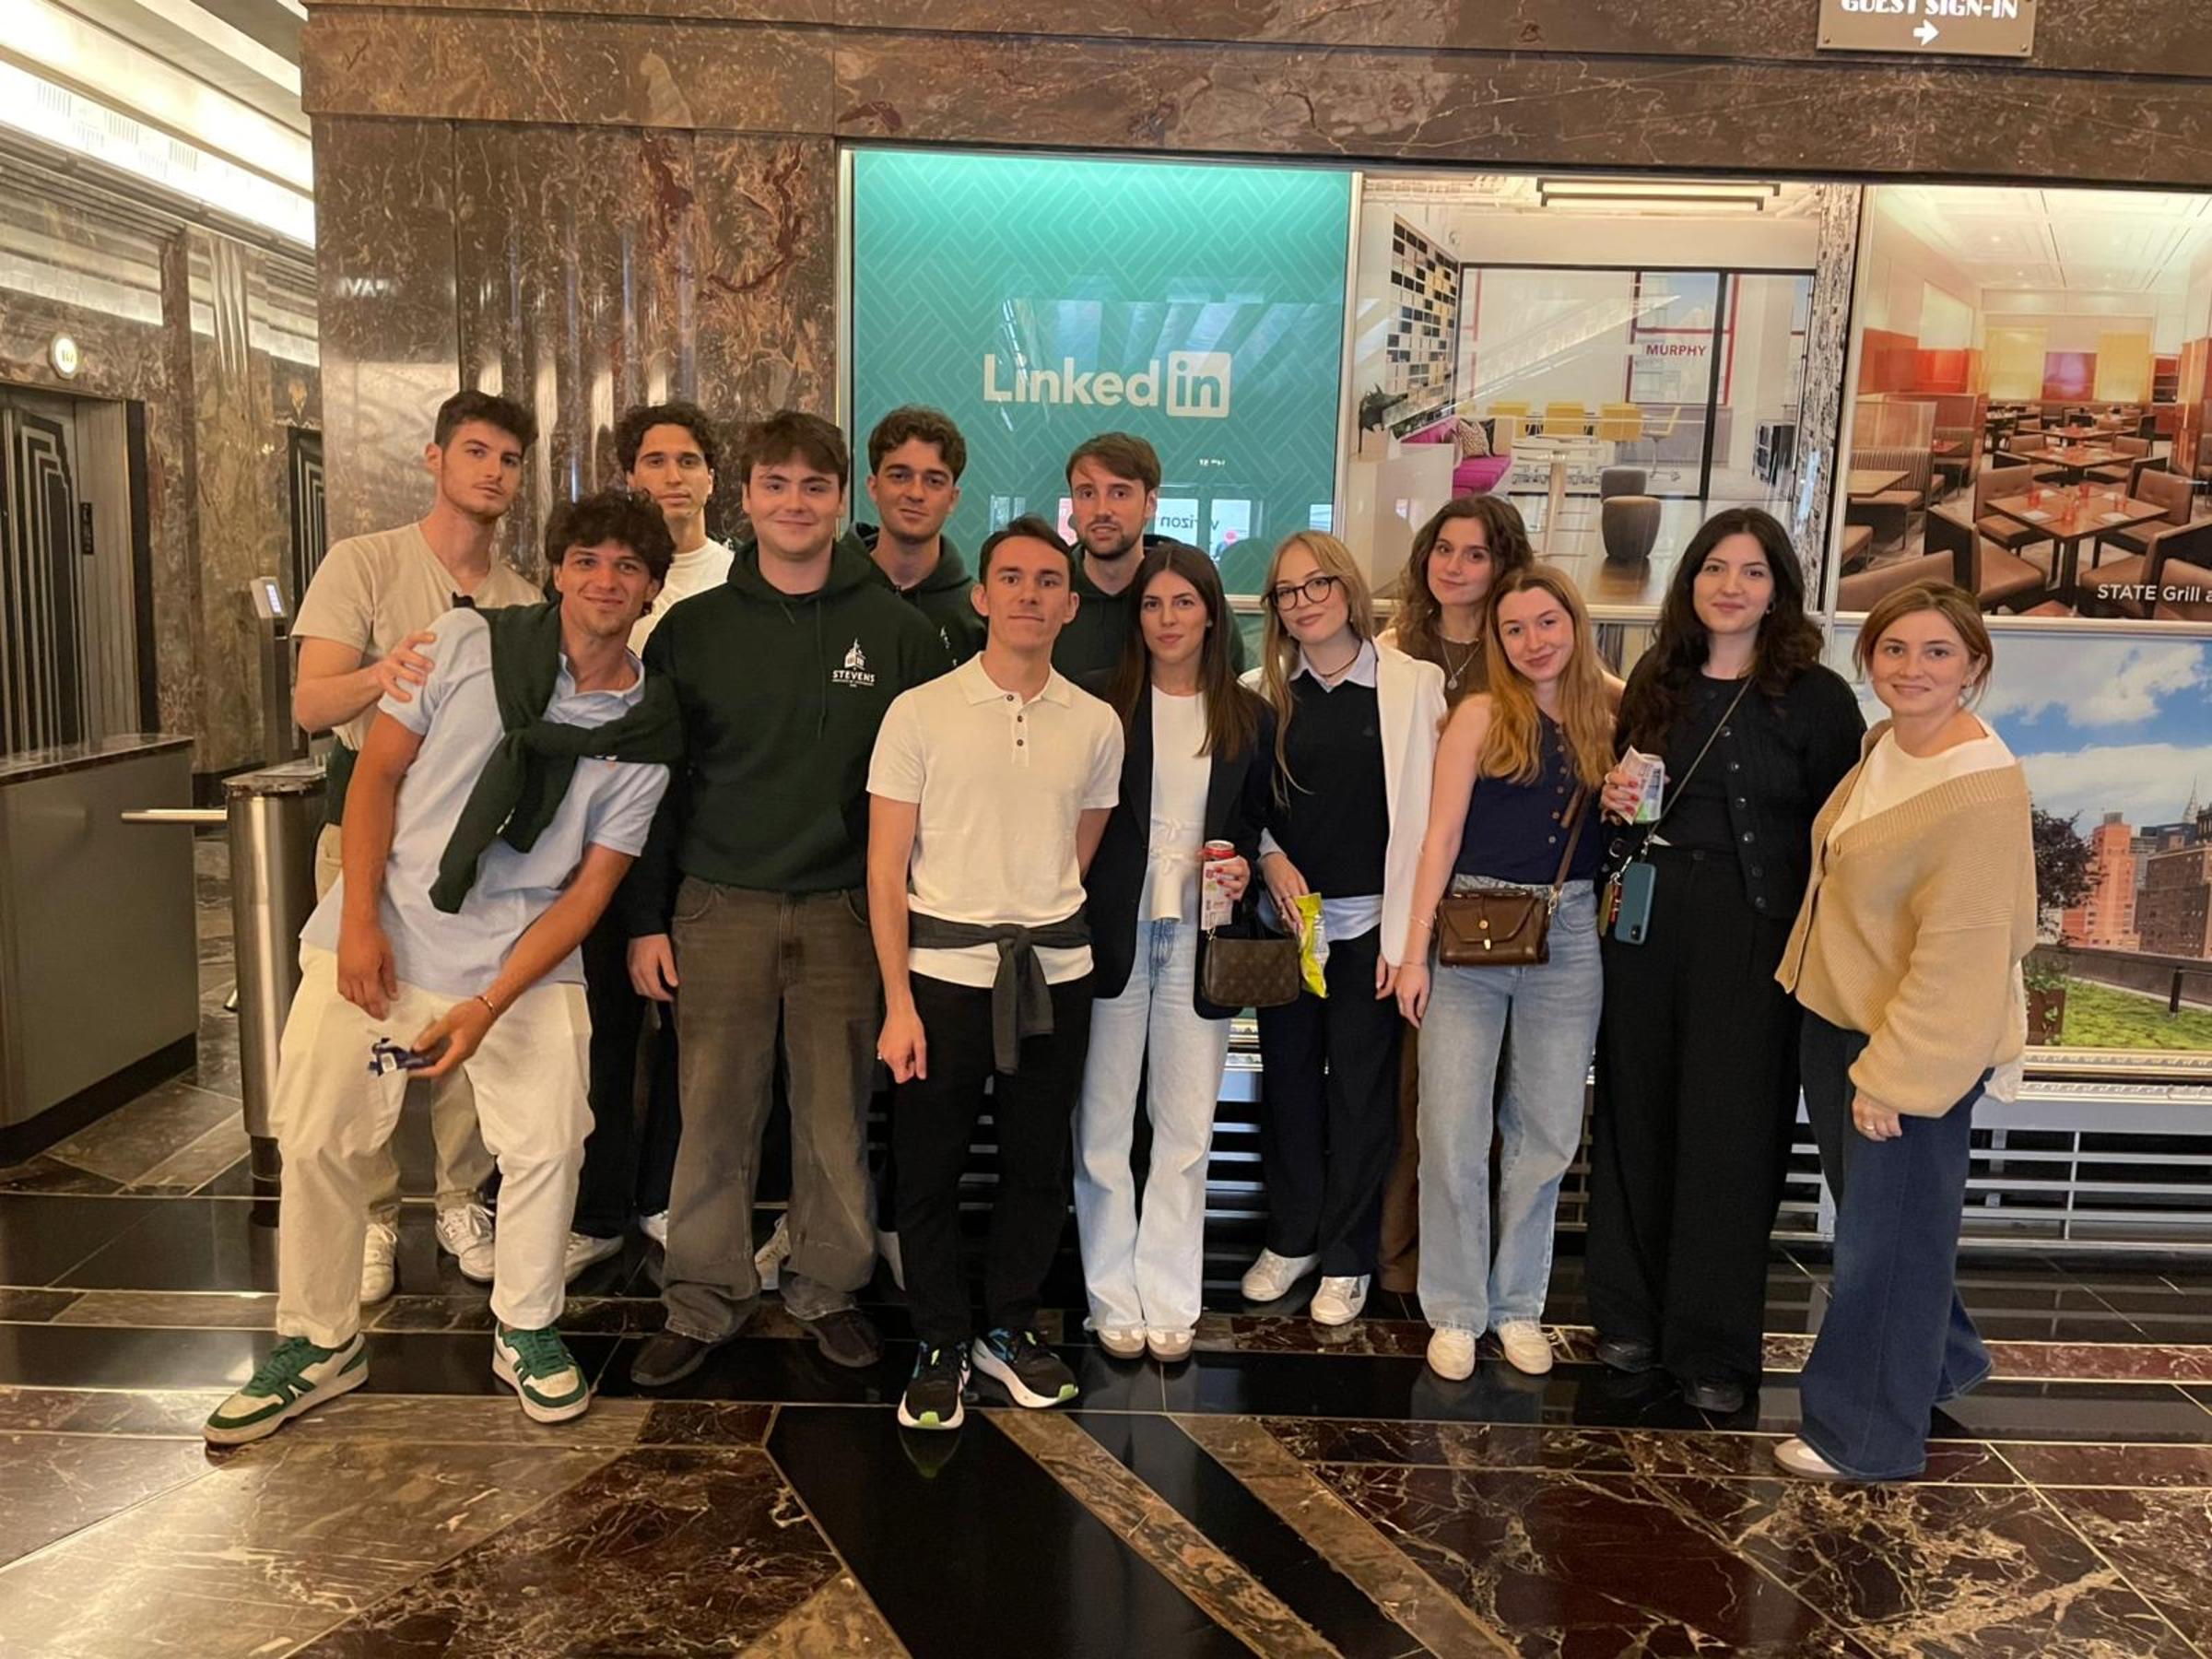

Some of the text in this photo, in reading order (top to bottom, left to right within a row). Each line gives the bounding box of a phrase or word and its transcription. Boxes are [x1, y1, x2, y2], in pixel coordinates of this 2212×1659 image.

[1646, 344, 1707, 357] MURPHY
[2097, 583, 2158, 601] STATE
[2162, 585, 2201, 602] Grill
[832, 670, 875, 682] STEVENS
